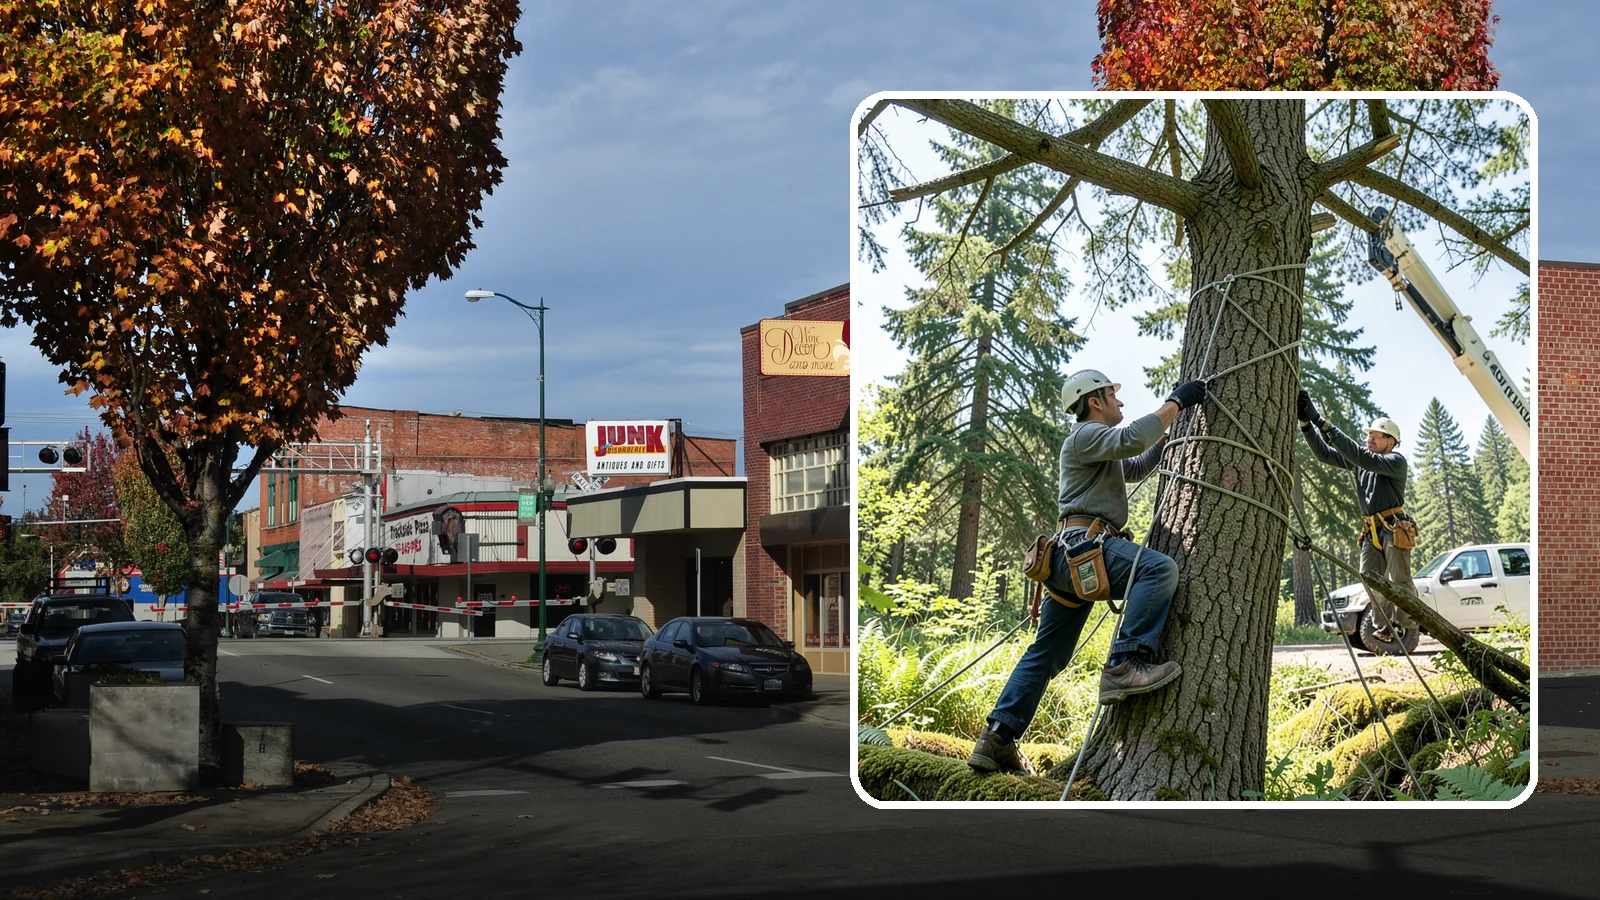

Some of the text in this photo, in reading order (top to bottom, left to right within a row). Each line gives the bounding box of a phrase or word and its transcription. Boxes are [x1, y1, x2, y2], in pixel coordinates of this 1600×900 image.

[764, 327, 831, 365] Decor
[596, 425, 664, 457] JUNK
[607, 446, 646, 454] DISORDERLY
[596, 460, 665, 470] ANTIQUES AND GIFTS
[390, 519, 429, 539] Trackside Pizza
